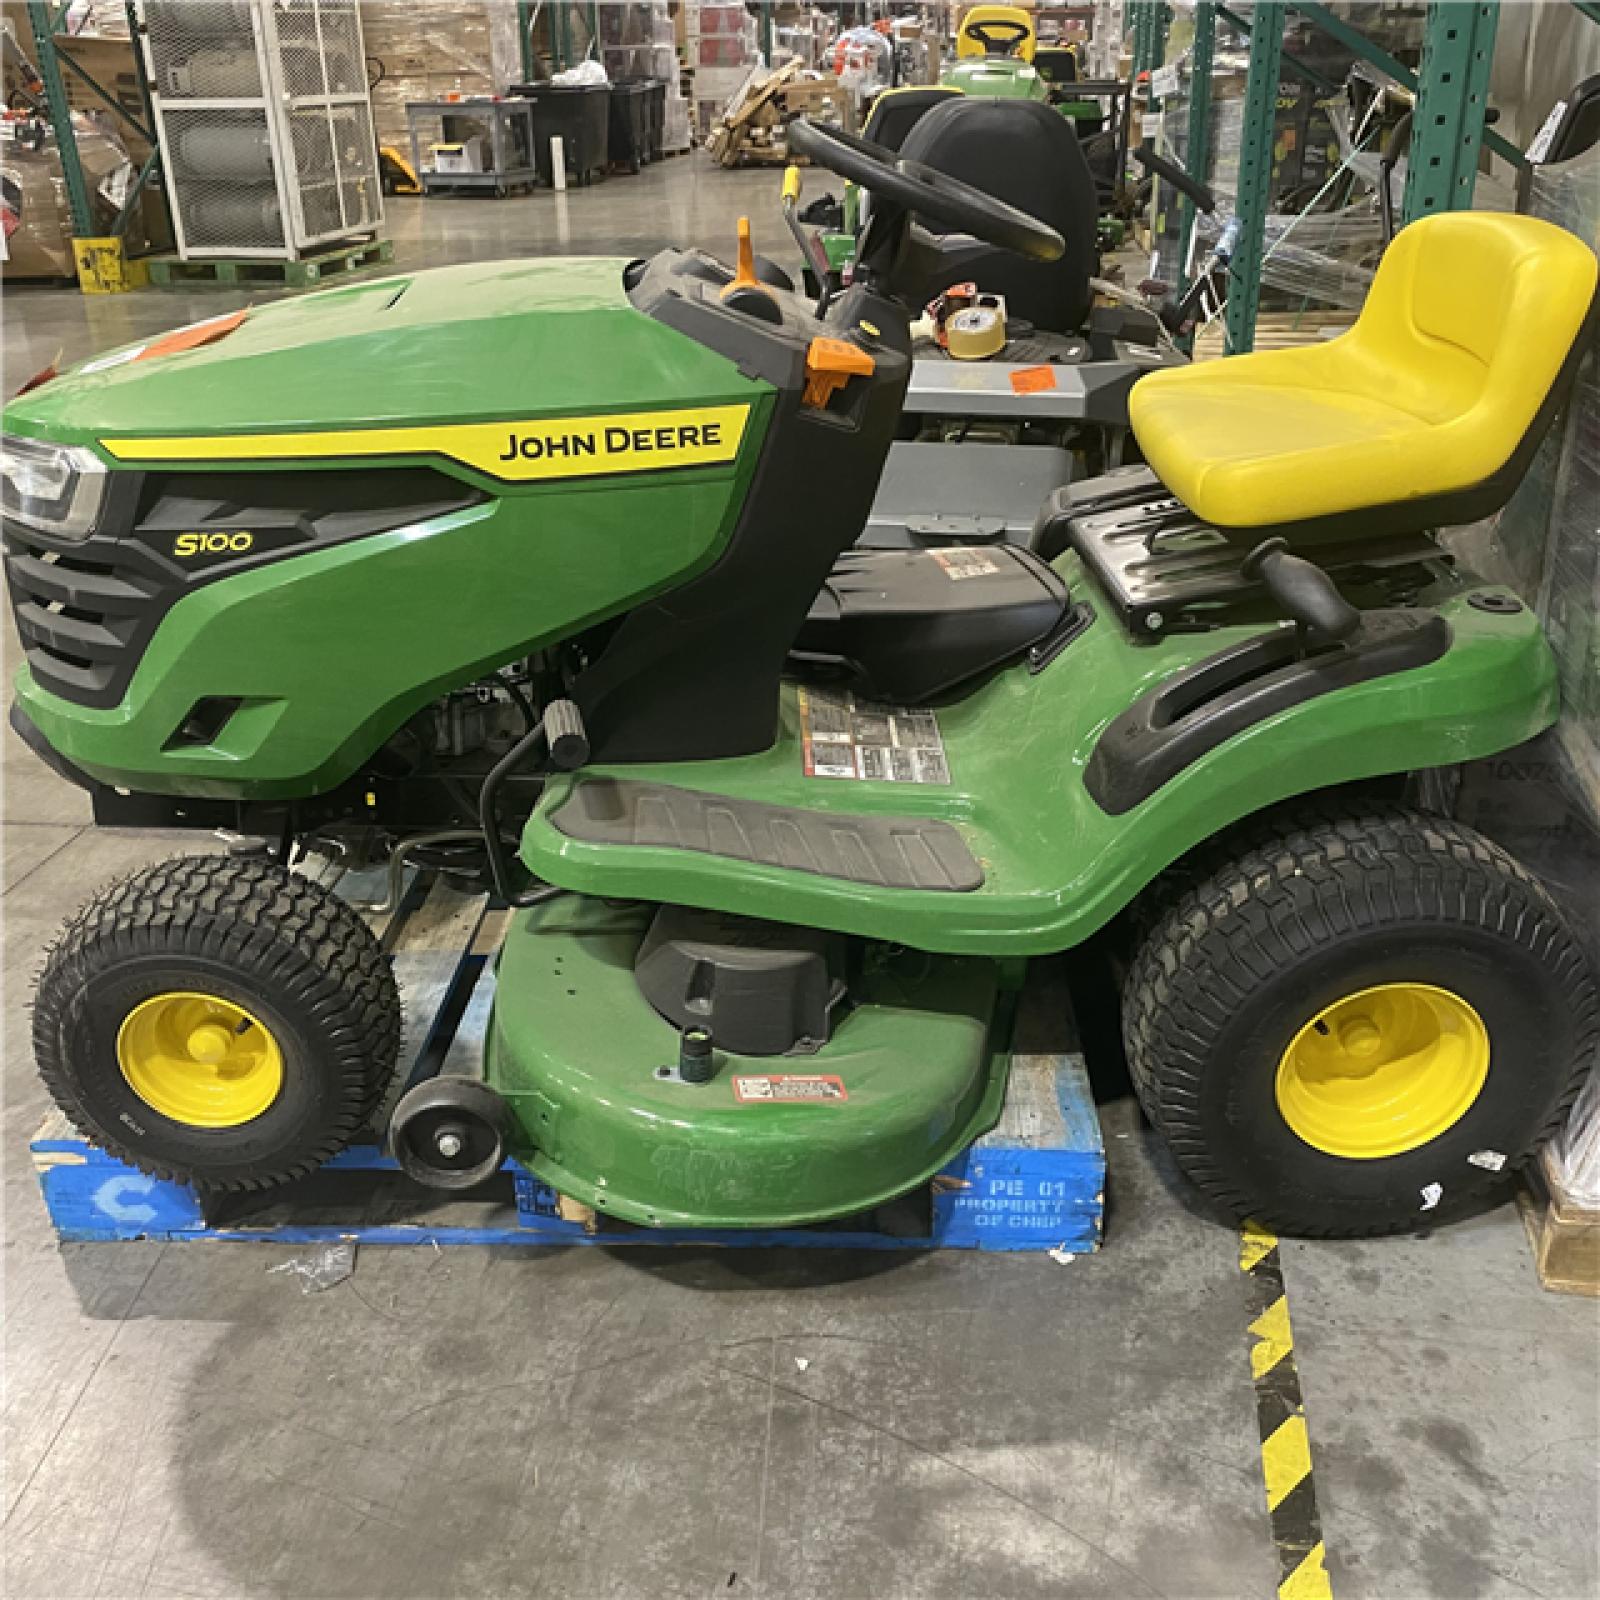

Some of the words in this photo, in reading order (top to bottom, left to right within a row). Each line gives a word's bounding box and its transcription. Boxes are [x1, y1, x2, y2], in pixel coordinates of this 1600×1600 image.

[499, 434, 596, 461] JOHN
[604, 423, 721, 453] DEERE
[174, 532, 253, 556] S100
[989, 1179, 1025, 1196] PE
[954, 1198, 1066, 1214] PROPERTY
[974, 1214, 1004, 1226] OF
